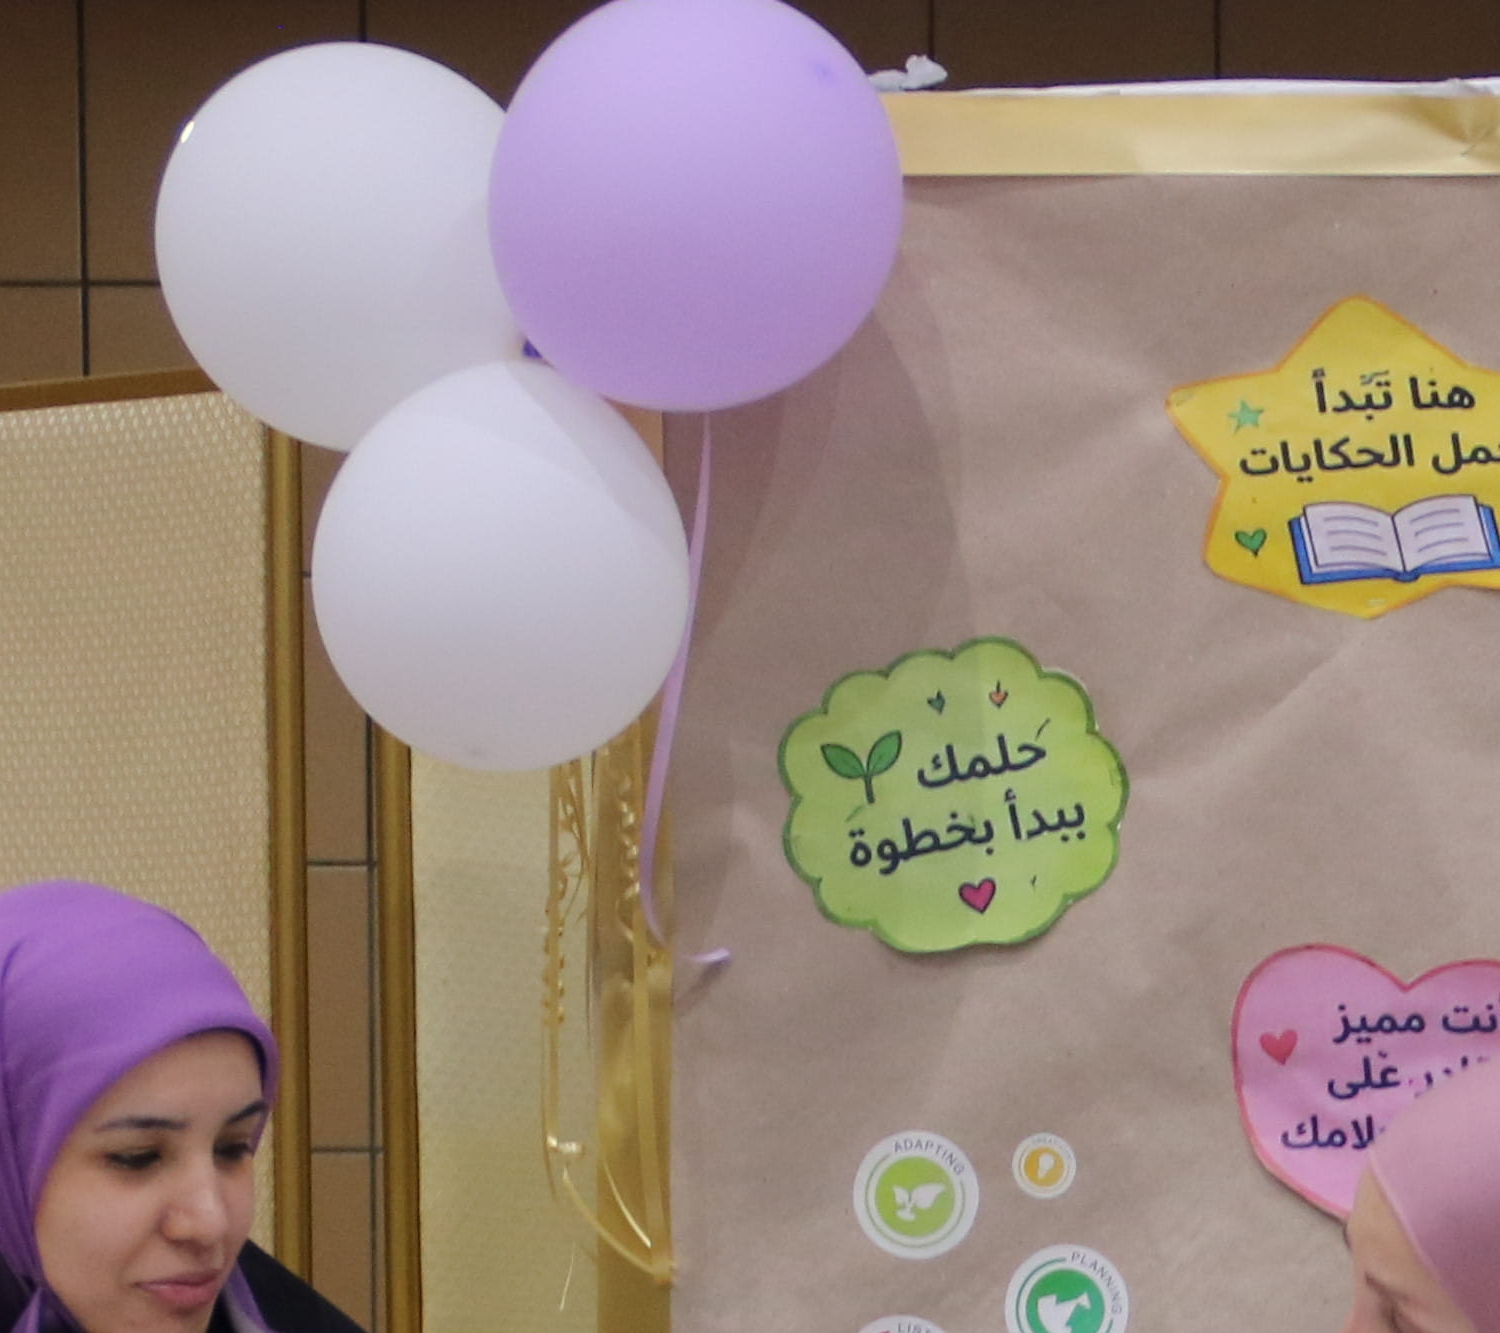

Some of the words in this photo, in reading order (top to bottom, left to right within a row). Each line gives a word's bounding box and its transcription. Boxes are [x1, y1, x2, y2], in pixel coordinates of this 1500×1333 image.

[1409, 376, 1476, 411] هنا
[1239, 433, 1415, 483] الحكايات
[1003, 787, 1086, 841] يبدأ
[848, 811, 995, 876] بخطوة
[1332, 1004, 1426, 1044] مميز
[894, 1138, 965, 1176] ADAPTING
[1071, 1251, 1123, 1314] PLANNING
